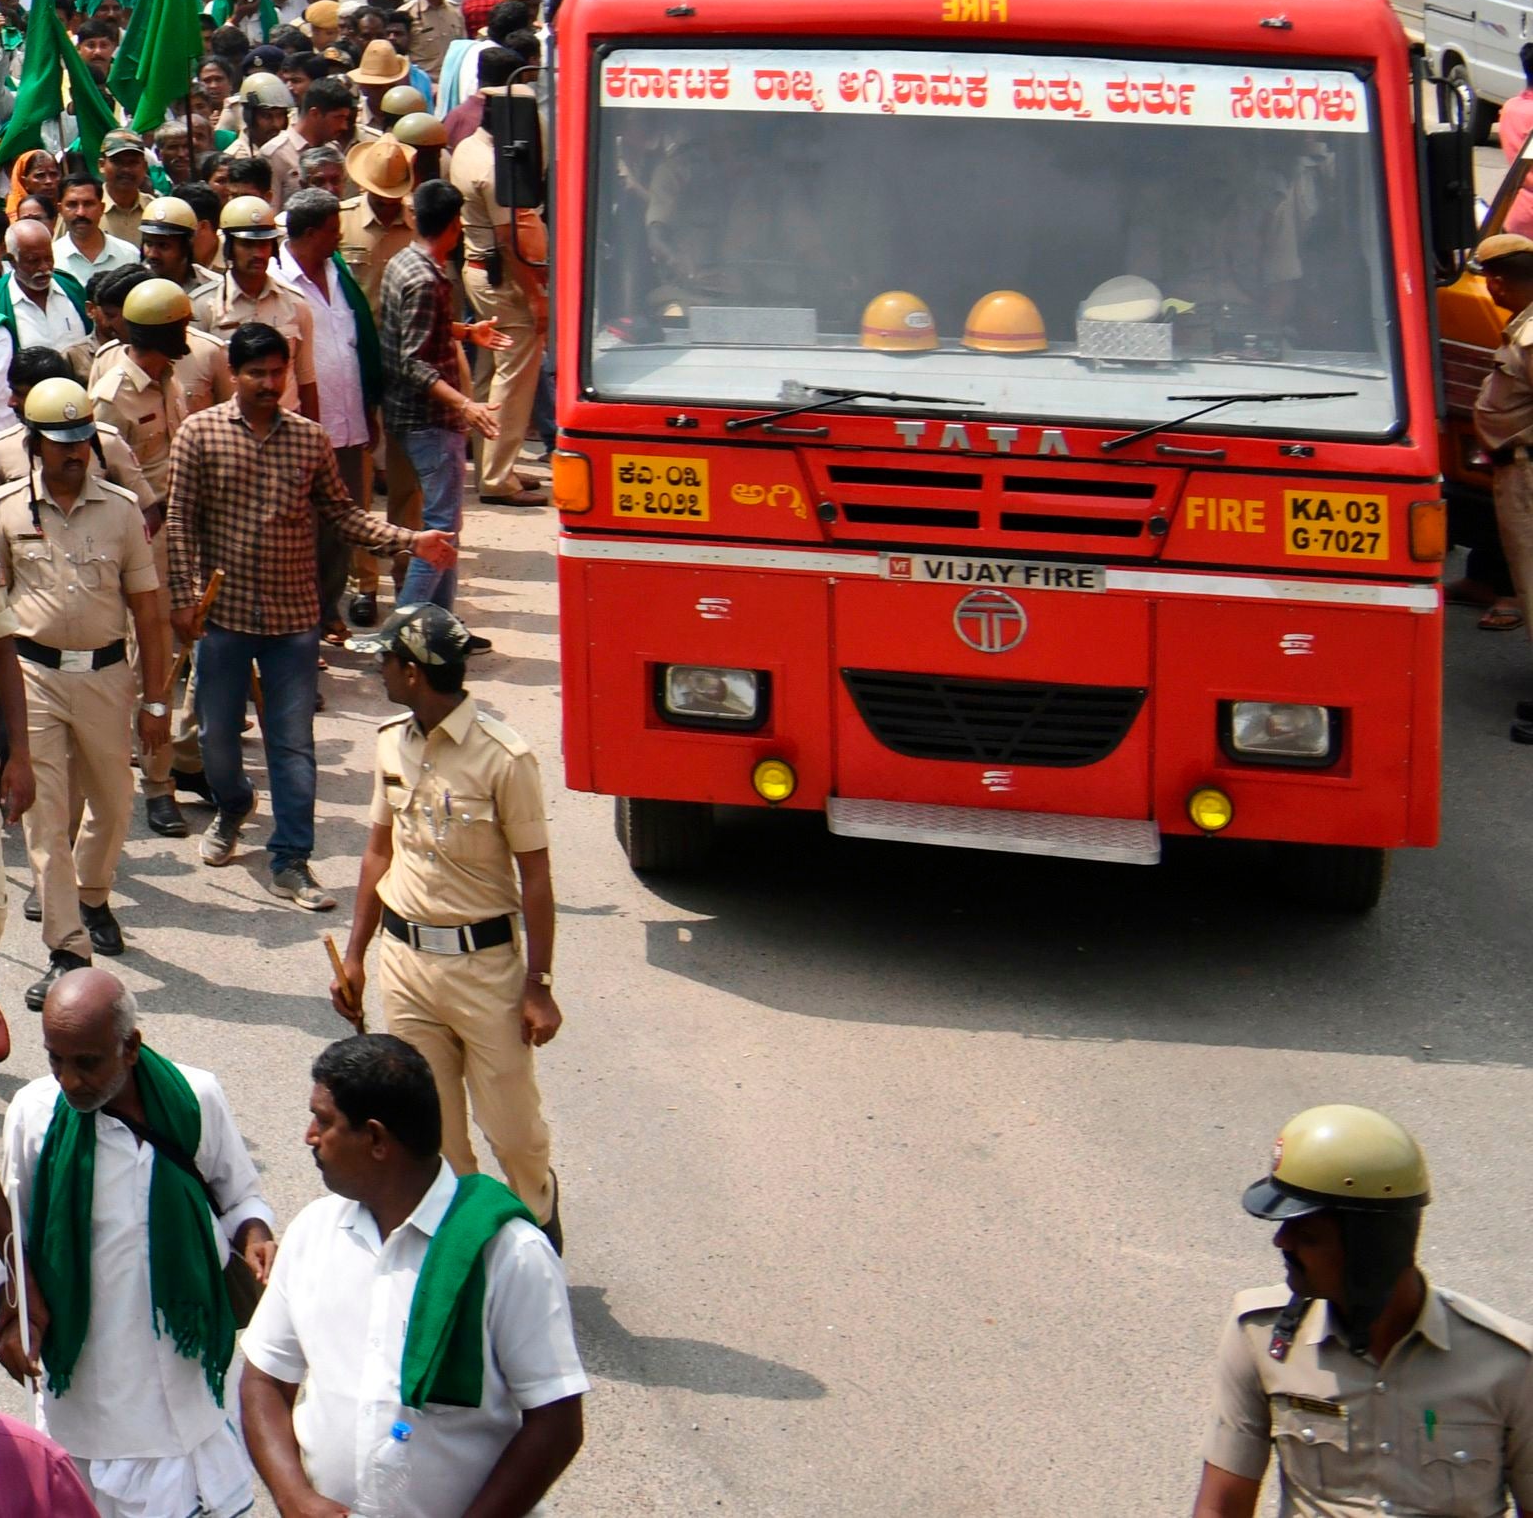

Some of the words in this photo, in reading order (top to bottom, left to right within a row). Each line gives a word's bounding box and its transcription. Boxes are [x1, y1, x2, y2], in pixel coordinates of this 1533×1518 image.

[605, 60, 731, 100] ಕರ್ನಾಟಕ
[753, 68, 825, 111] ರಾಜ್ಯ
[838, 64, 988, 114] ಅಗ್ನಿಶಾಮಕ
[1013, 70, 1093, 118] ಮತ್ತು
[1230, 75, 1357, 122] ಸೇವೆಗಳು
[893, 420, 1070, 456] TATA
[730, 483, 808, 520] ಅಗ್ನಿ
[1186, 496, 1266, 533] FIRE
[924, 560, 1015, 584] VIJAY
[1024, 565, 1095, 589] FIRE
